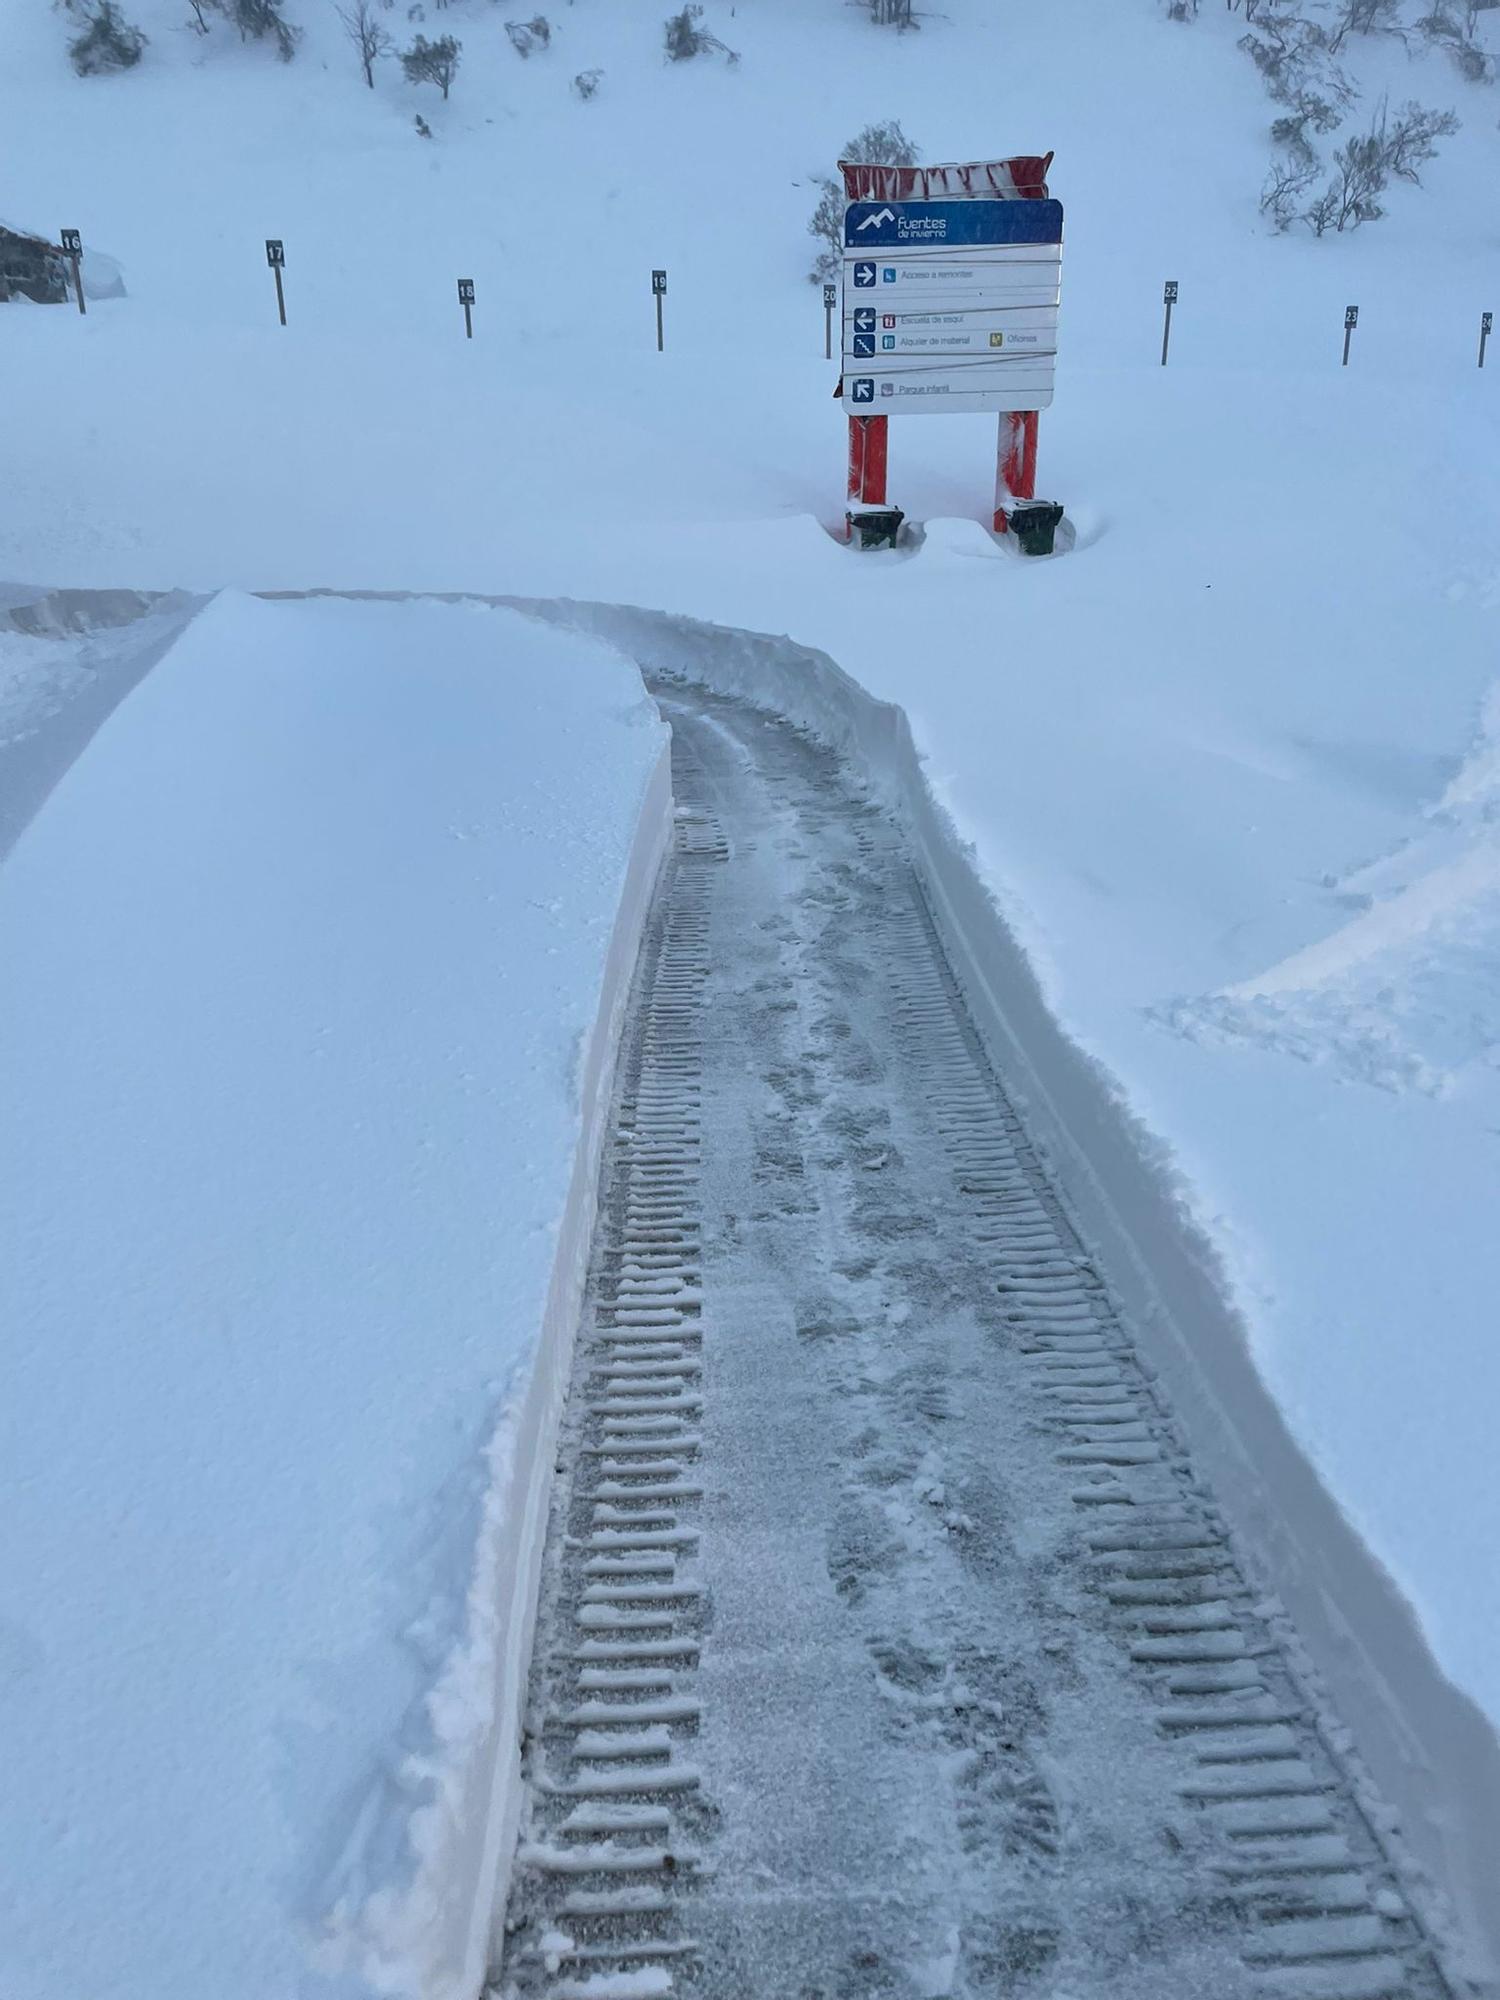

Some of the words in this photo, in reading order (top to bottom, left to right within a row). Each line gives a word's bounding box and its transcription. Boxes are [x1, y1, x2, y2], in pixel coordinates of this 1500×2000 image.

[898, 216, 946, 230] Fuentes
[898, 230, 909, 238] de
[910, 230, 946, 238] invierno
[64, 236, 80, 249] 16
[268, 247, 283, 259] 17
[901, 271, 929, 279] Acceso
[938, 270, 973, 278] remontes
[654, 276, 666, 287] 19
[460, 285, 474, 297] 18
[824, 290, 836, 301] 20
[1165, 287, 1177, 298] 22
[901, 316, 929, 325] Escuela
[931, 316, 941, 324] de
[1346, 312, 1357, 322] 23
[1482, 318, 1492, 328] 24
[929, 337, 939, 345] de
[941, 336, 970, 345] material
[1007, 335, 1037, 343] Oficinas
[899, 386, 925, 395] Parque
[926, 385, 950, 393] infantil
